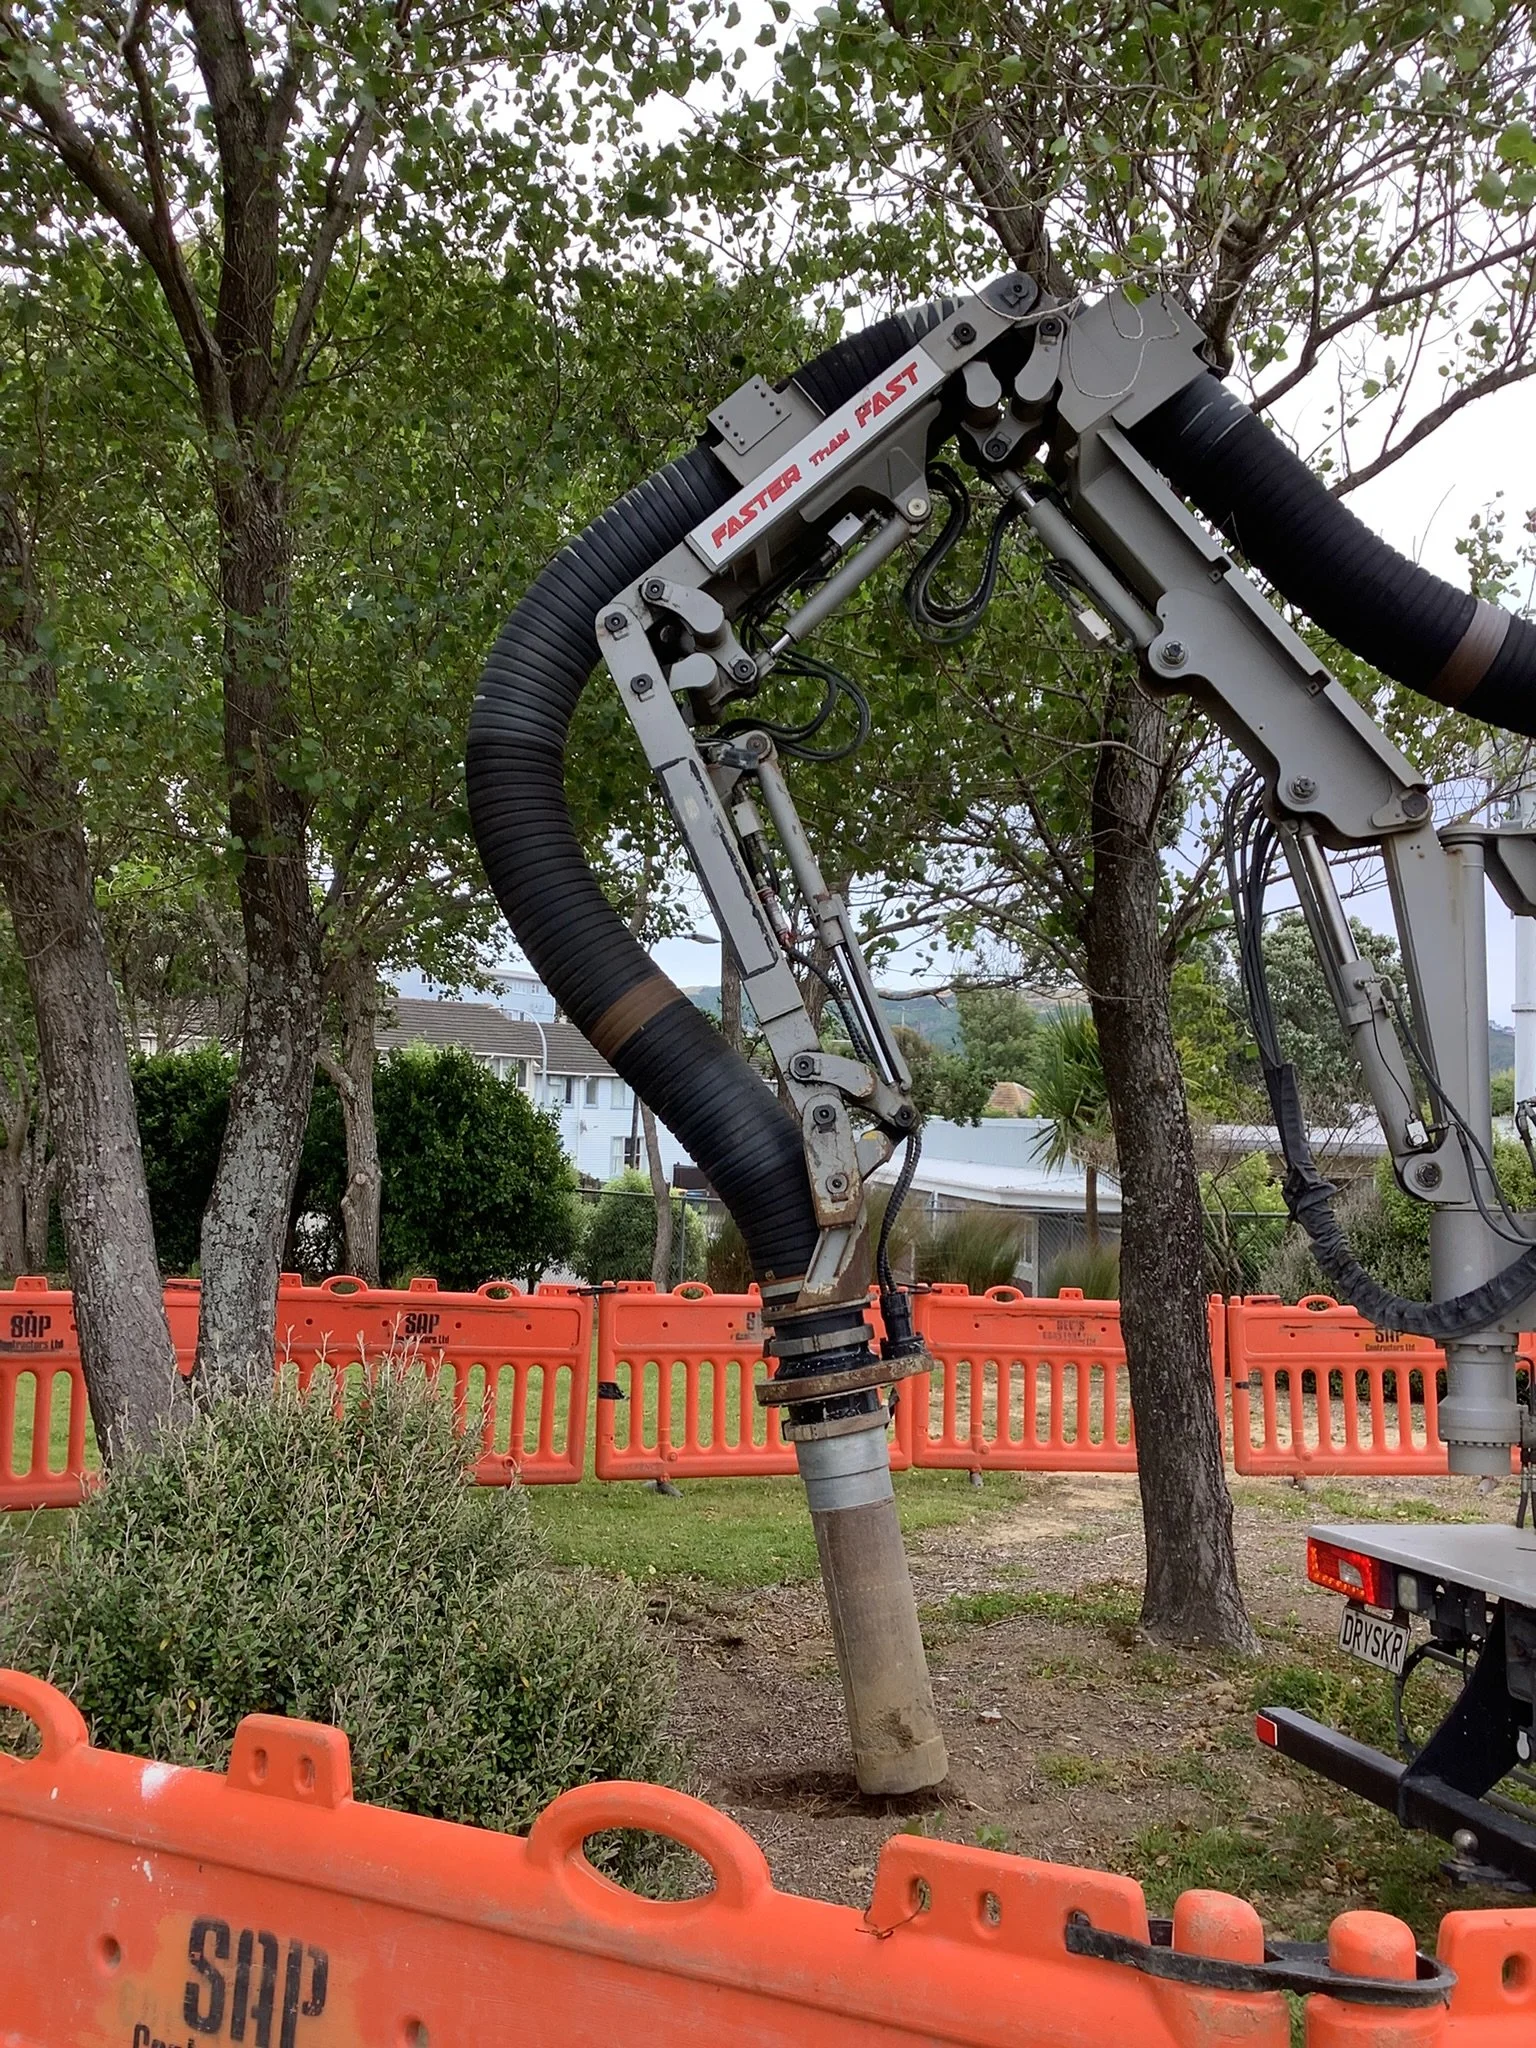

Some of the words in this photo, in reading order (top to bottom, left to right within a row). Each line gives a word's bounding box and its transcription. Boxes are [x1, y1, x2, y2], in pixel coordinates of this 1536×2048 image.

[711, 463, 802, 549] FASTER
[854, 361, 919, 428] FAST
[10, 1314, 52, 1338] SAP
[405, 1312, 440, 1334] SAP
[50, 1339, 64, 1350] Ltd
[438, 1334, 450, 1344] Ltd
[1405, 1343, 1416, 1352] Ltd
[1342, 1614, 1403, 1667] DRYSKR
[183, 1915, 329, 2048] SAP
